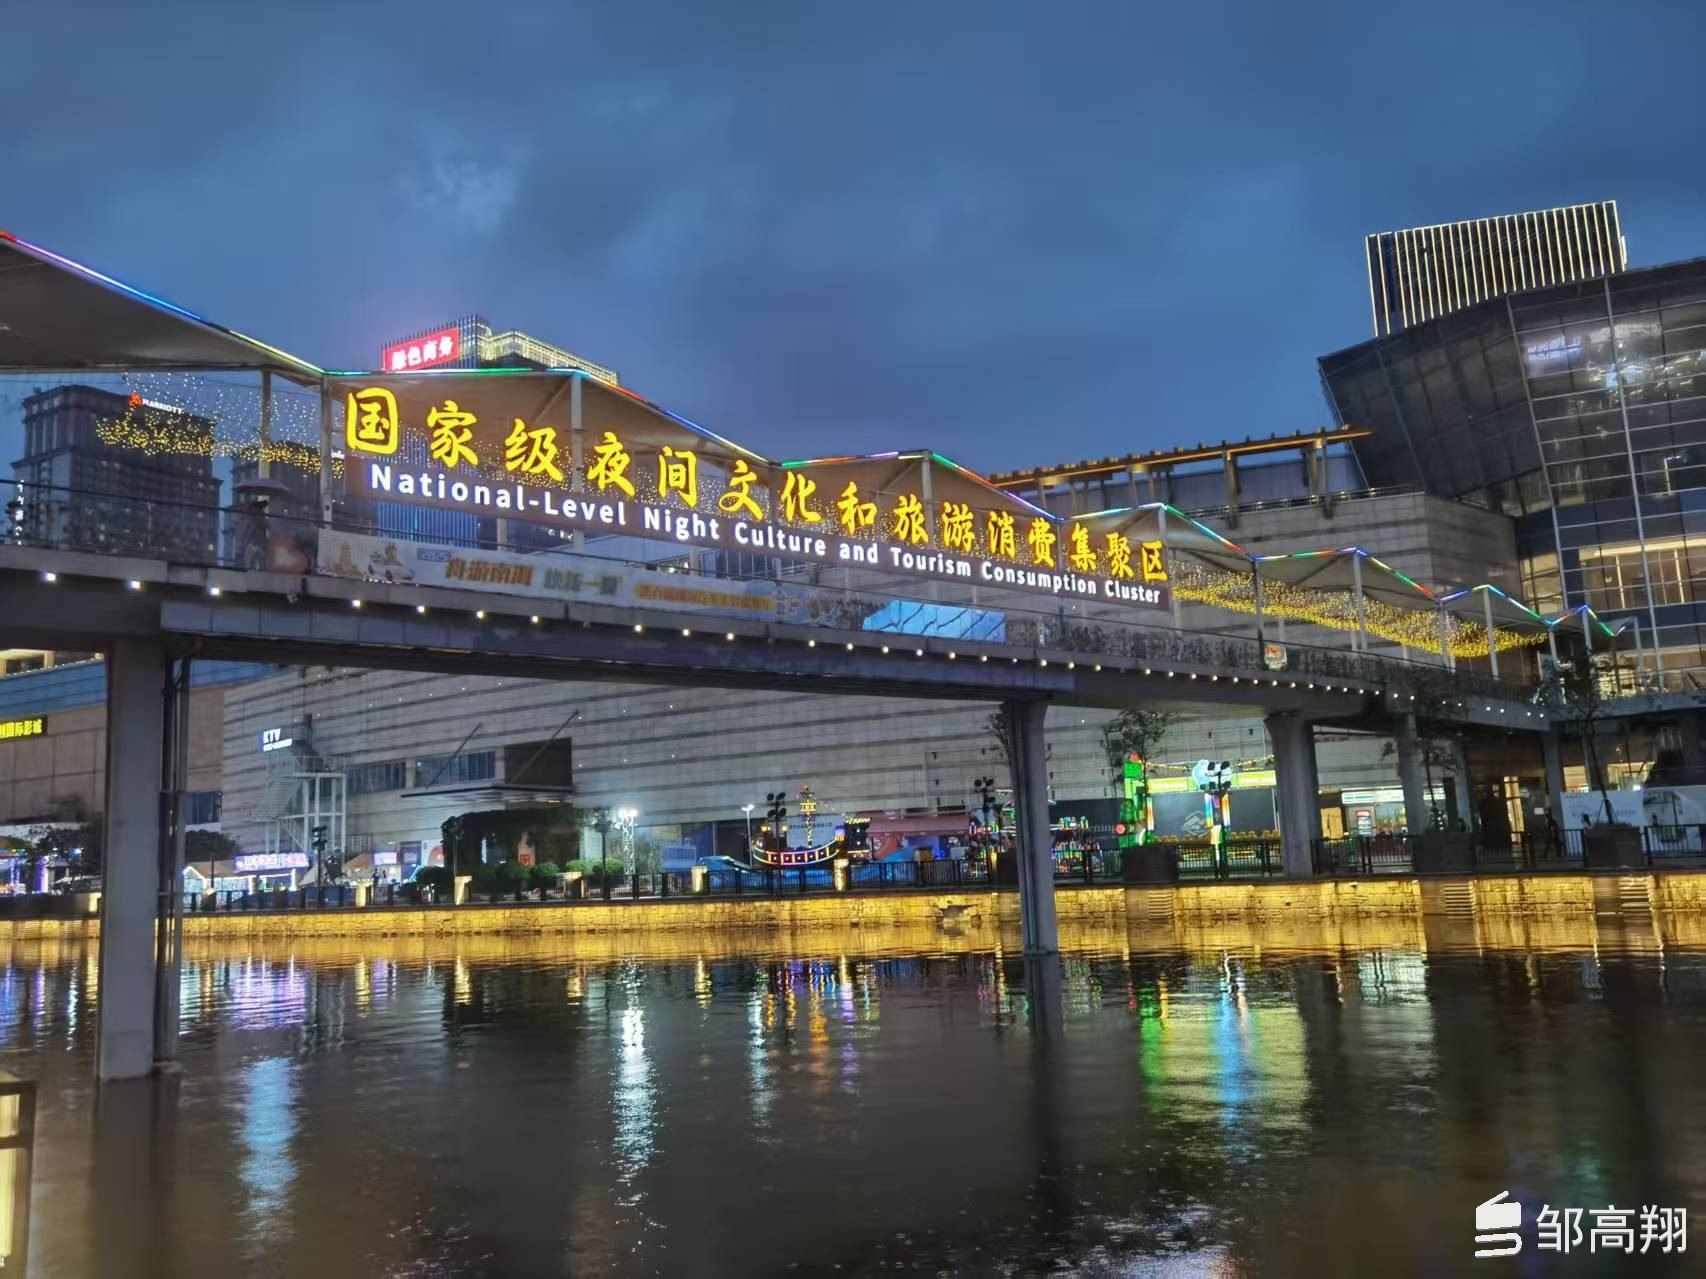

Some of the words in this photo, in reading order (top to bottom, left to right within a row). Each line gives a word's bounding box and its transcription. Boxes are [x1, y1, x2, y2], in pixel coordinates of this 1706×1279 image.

[142, 398, 183, 415] MARRIOTT
[345, 386, 1169, 583] 国家级夜间文化和旅游消费集聚区
[371, 463, 627, 527] National-Level
[643, 506, 721, 542] Night
[734, 521, 827, 557] Culture
[838, 541, 880, 565] and
[889, 546, 972, 578] Tourism
[980, 560, 1098, 595] Consumption
[1103, 578, 1162, 604] Cluster
[263, 727, 281, 744] KTV
